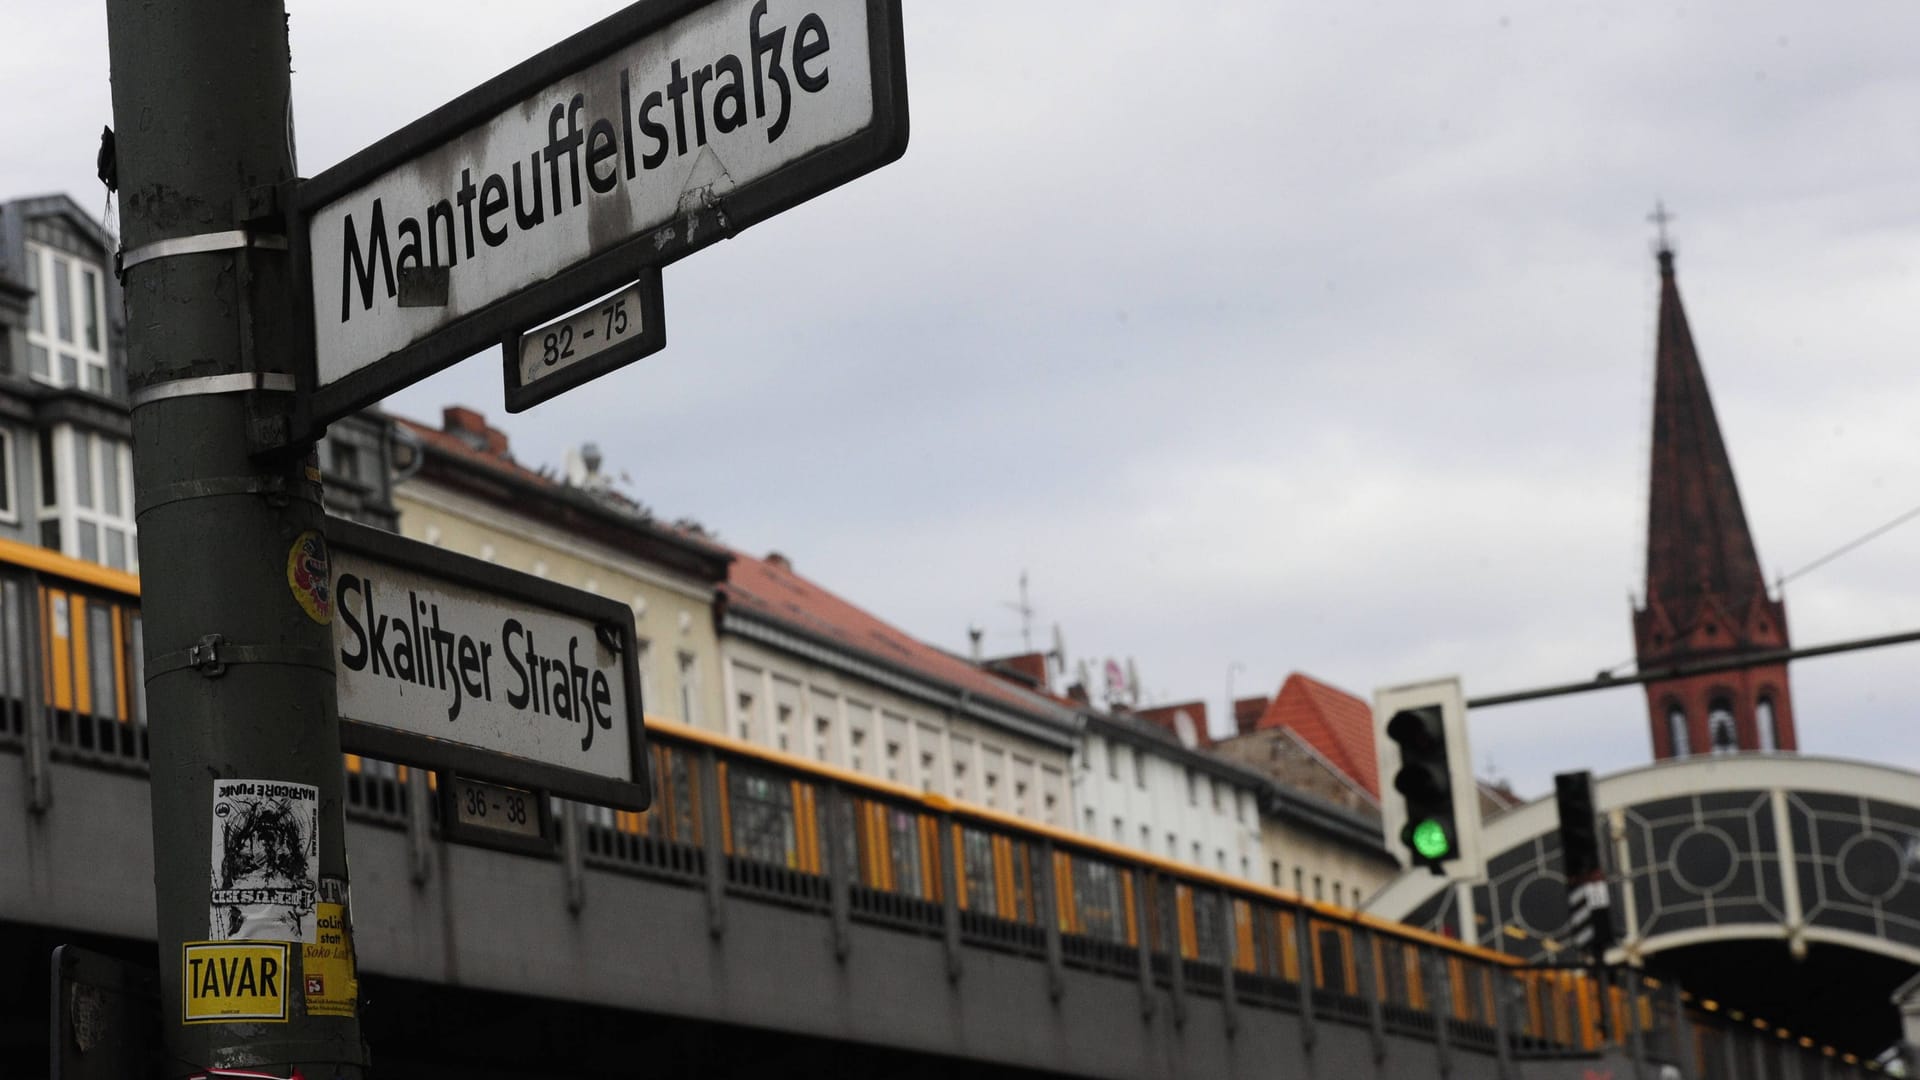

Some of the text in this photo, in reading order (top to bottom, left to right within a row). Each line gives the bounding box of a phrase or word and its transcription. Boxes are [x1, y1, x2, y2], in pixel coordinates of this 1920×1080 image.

[341, 0, 830, 323] Manteuffelstraße
[543, 325, 574, 366] 82
[602, 299, 627, 340] 75
[336, 573, 492, 722] Skalitzer
[502, 618, 612, 752] Straße
[257, 784, 316, 801] HARDCORE
[466, 788, 487, 817] 36
[506, 795, 526, 825] 38
[189, 957, 278, 998] TAVAR
